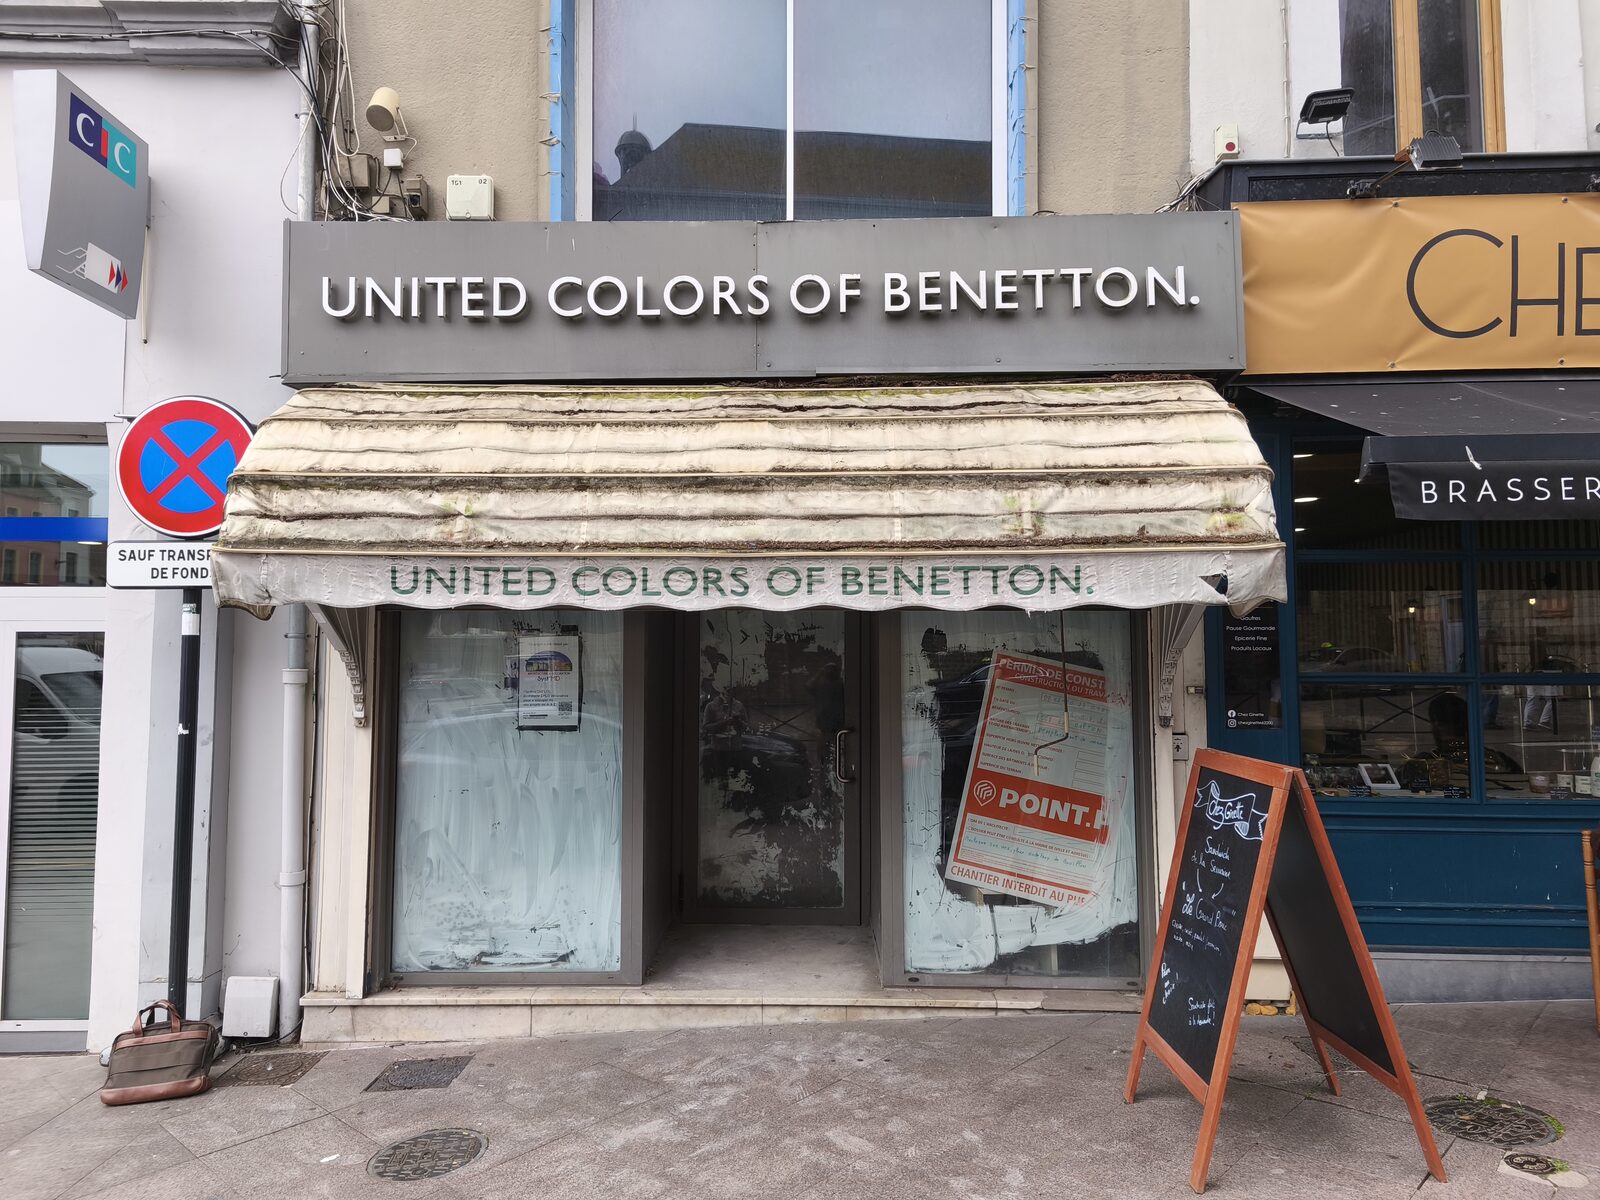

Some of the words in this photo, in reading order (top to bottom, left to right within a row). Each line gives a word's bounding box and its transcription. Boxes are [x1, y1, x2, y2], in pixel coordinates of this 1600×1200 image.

[75, 111, 131, 175] CIC
[321, 275, 528, 319] UNITED
[547, 274, 770, 319] COLORS
[789, 273, 862, 316] OF
[884, 265, 1200, 314] BENETTON.
[118, 549, 156, 562] SAUF
[151, 567, 168, 580] DE
[390, 565, 557, 596] UNITED
[571, 565, 750, 597] COLORS
[766, 565, 826, 596] OF
[841, 563, 1095, 597] BENETTON.
[1048, 668, 1062, 680] DE
[952, 864, 1000, 886] CHANTIER
[1001, 878, 1047, 897] INTERDIT
[1049, 889, 1064, 902] AU
